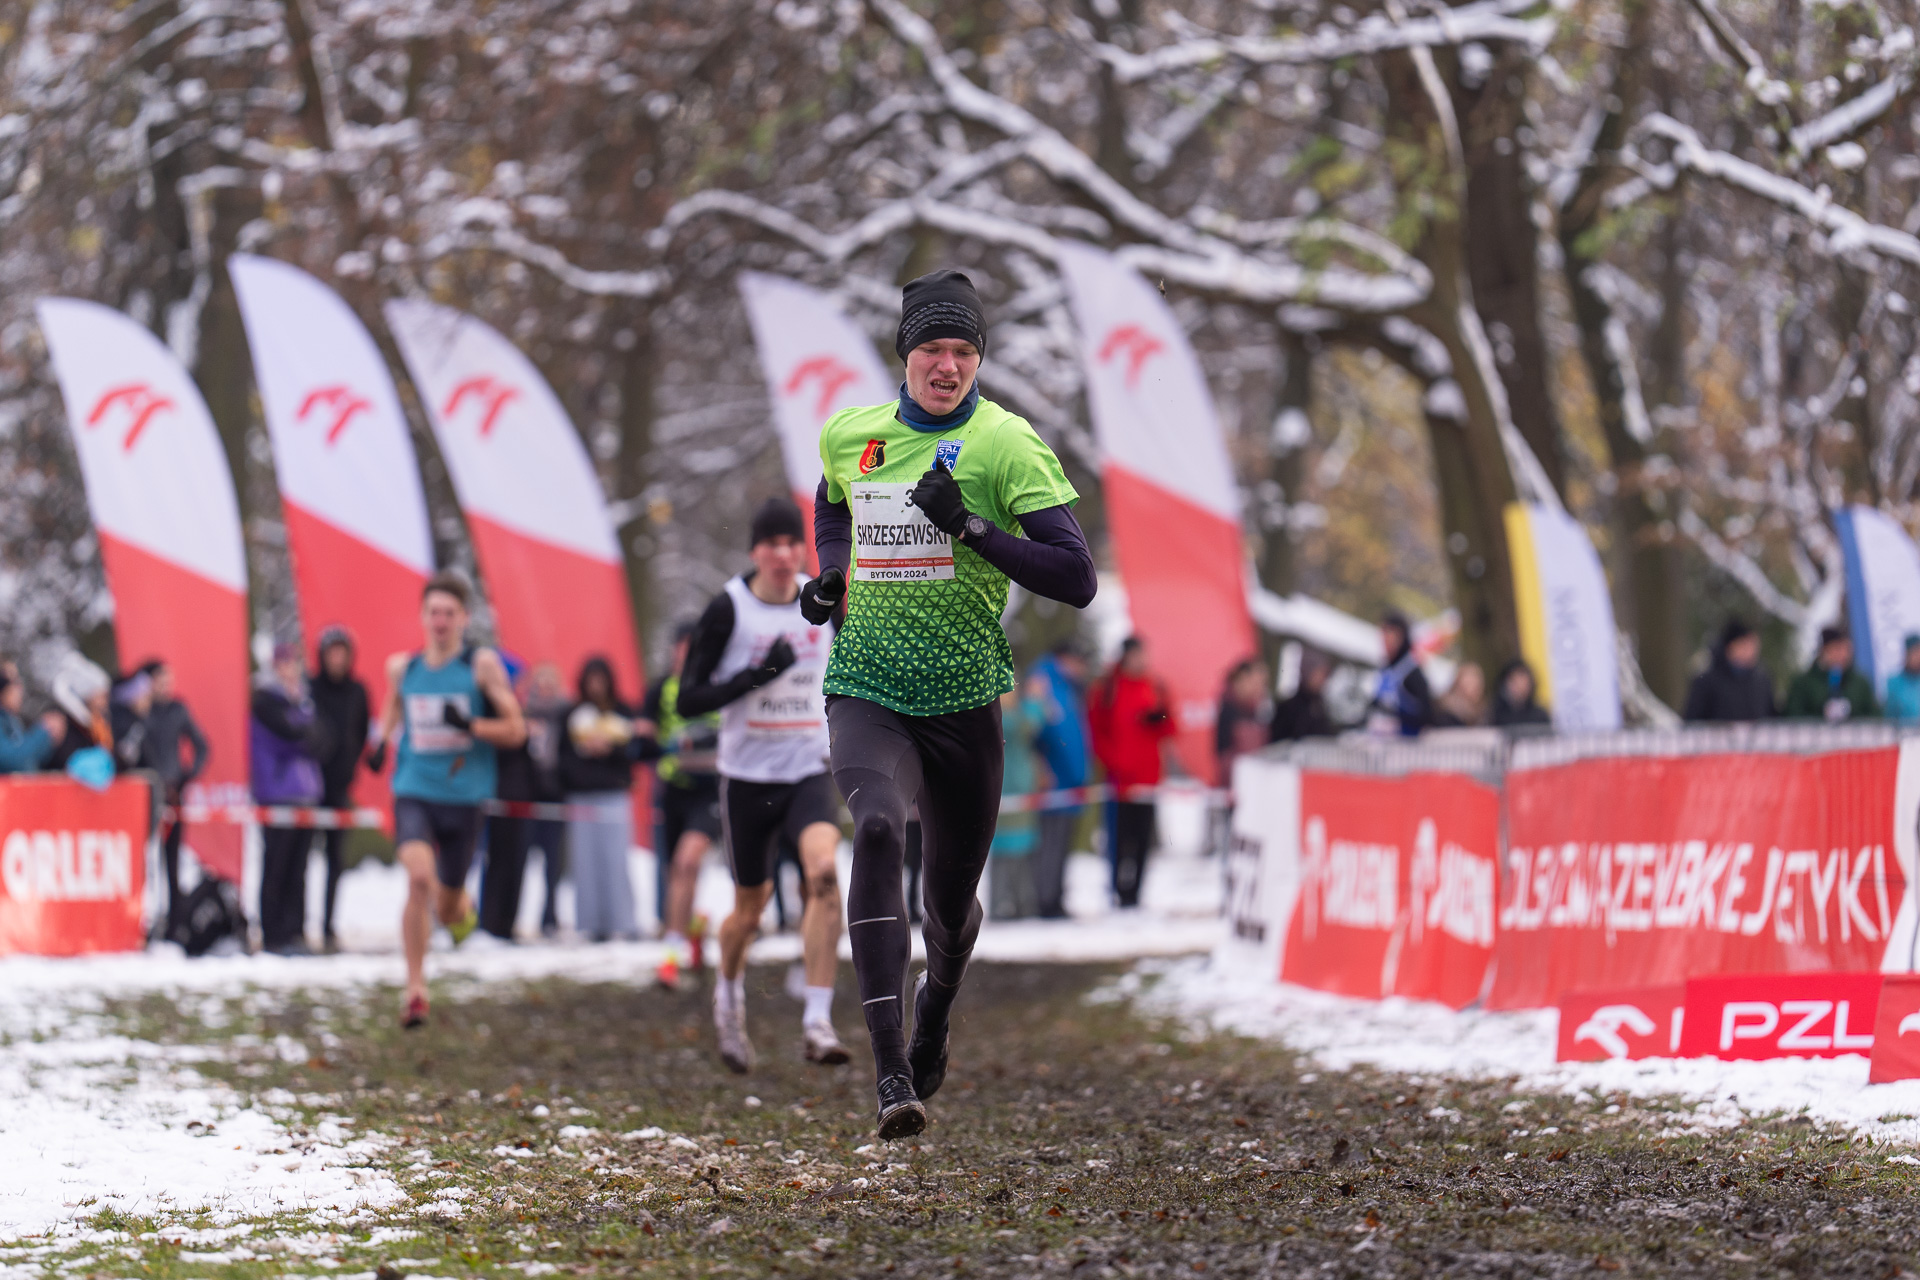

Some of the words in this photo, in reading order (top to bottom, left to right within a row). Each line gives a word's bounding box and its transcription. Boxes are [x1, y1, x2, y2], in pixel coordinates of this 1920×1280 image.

[870, 571, 902, 579] BYTOM
[903, 570, 928, 578] 2024
[2, 829, 132, 902] ORLEN
[1719, 1000, 1876, 1051] PZL
